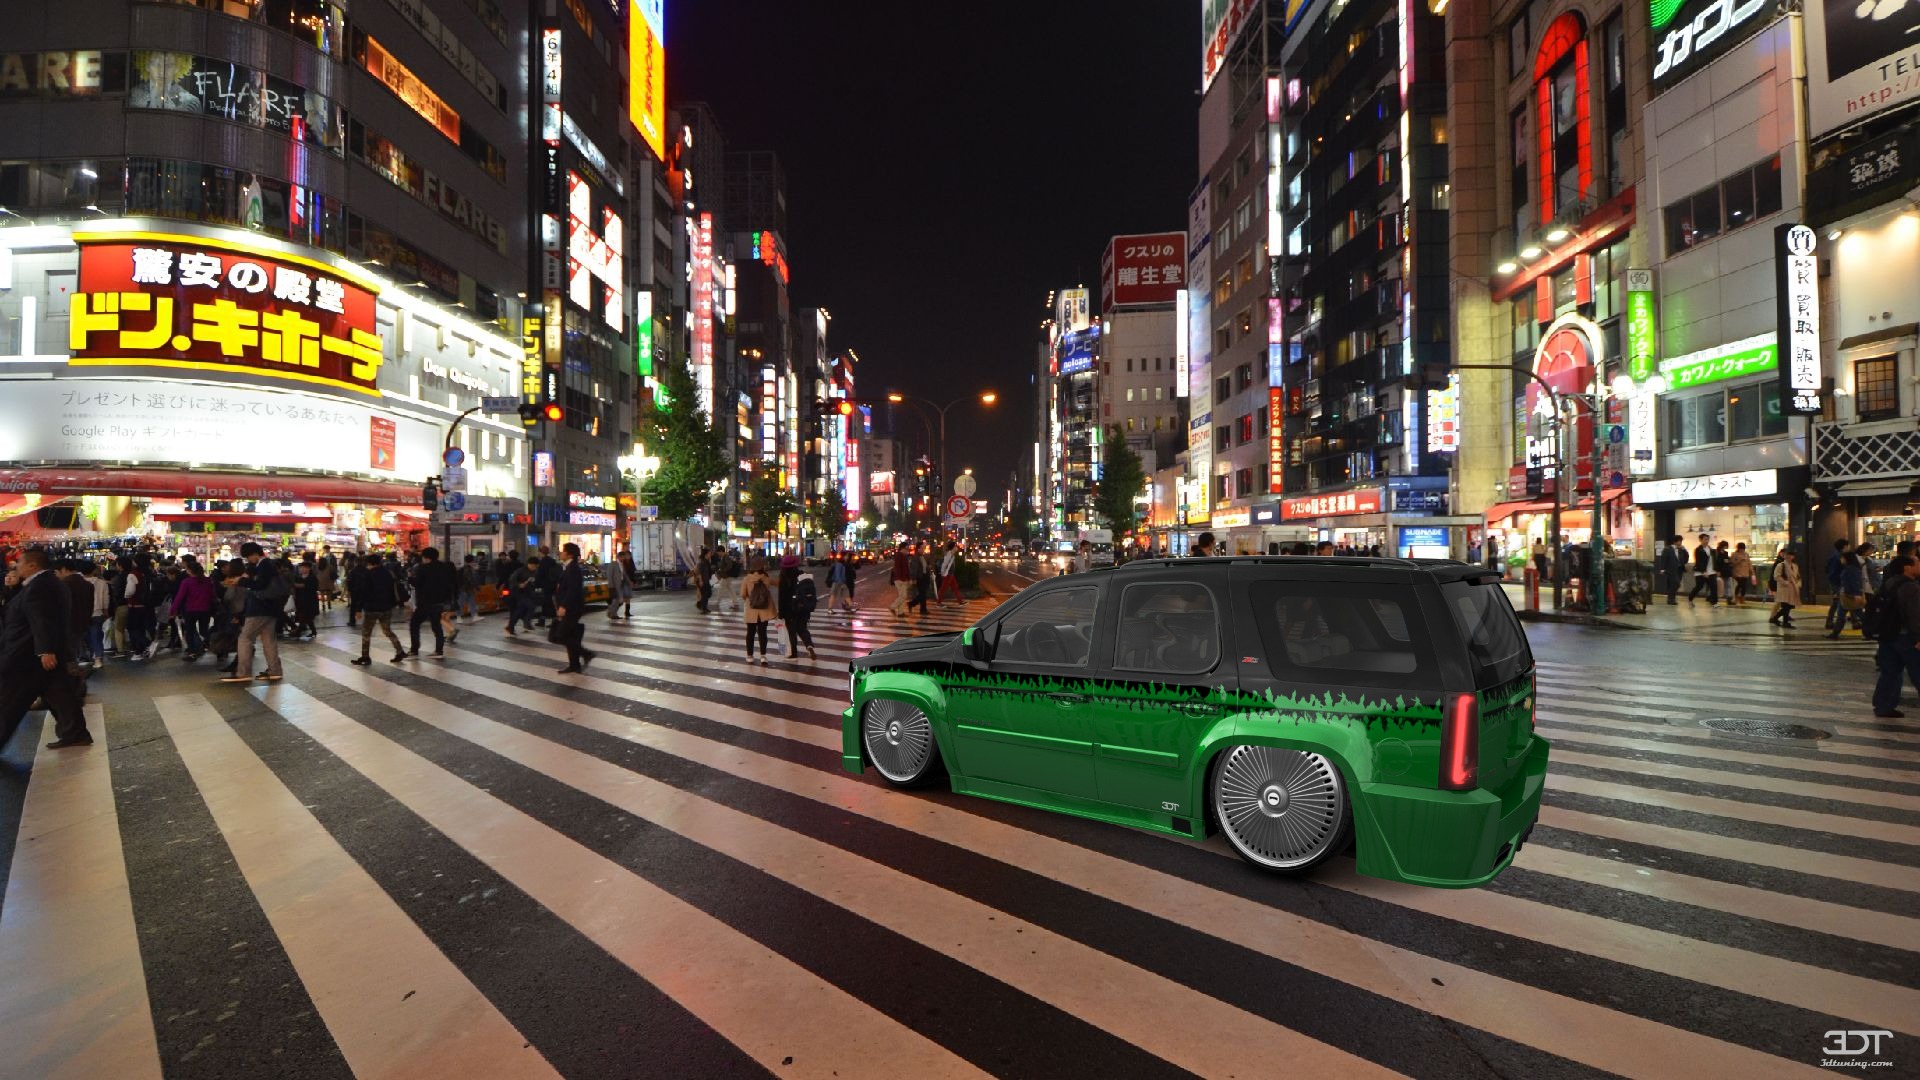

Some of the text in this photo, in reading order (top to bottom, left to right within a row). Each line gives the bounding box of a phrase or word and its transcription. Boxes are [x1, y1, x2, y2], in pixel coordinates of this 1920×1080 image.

[193, 70, 303, 118] FLARE
[1123, 244, 1175, 259] クスリの
[131, 246, 346, 315] 驚安の殿堂
[61, 424, 105, 439] Google
[110, 425, 137, 440] Play
[195, 485, 294, 500] Don Quijote
